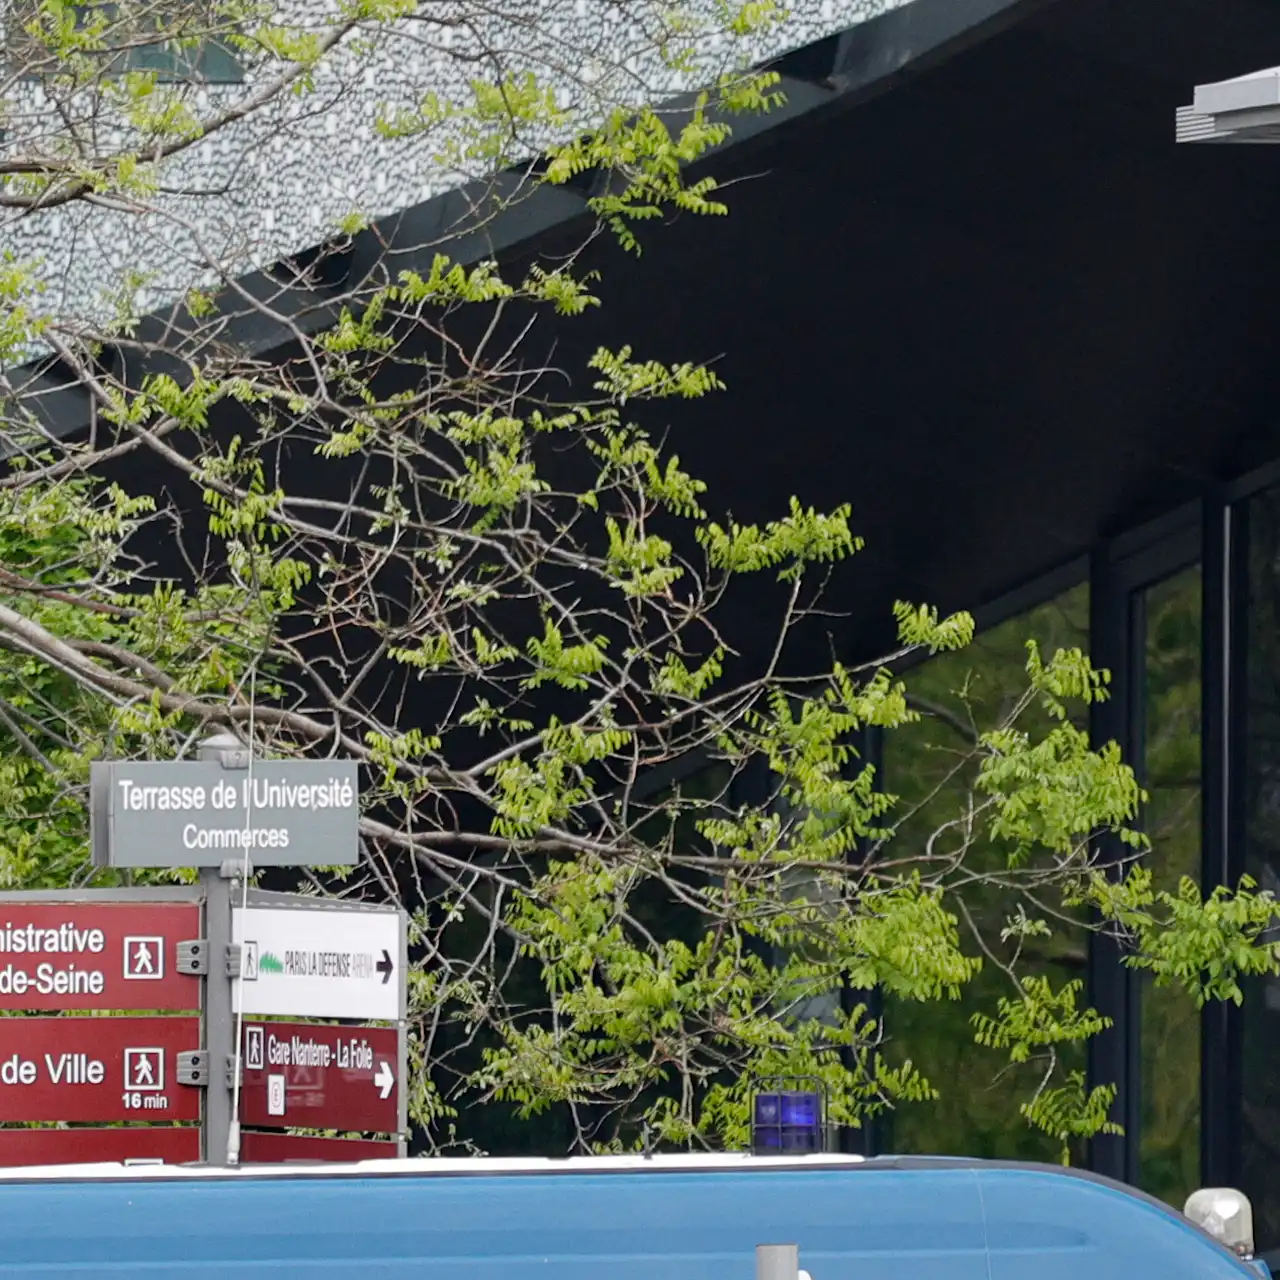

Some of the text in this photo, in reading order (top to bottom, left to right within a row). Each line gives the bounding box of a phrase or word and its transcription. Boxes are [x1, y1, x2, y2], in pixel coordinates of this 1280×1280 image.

[118, 776, 354, 811] Terrasse de l'Université
[182, 823, 290, 849] Commerces
[284, 950, 307, 976] PARIS
[308, 951, 317, 976] LA
[267, 1033, 291, 1065] Gare
[291, 1035, 331, 1068] Nanterre
[336, 1037, 350, 1068] La
[350, 1038, 373, 1070] Folie
[0, 1053, 37, 1085] de
[44, 1053, 105, 1085] Ville
[122, 1092, 168, 1109] 16 min
